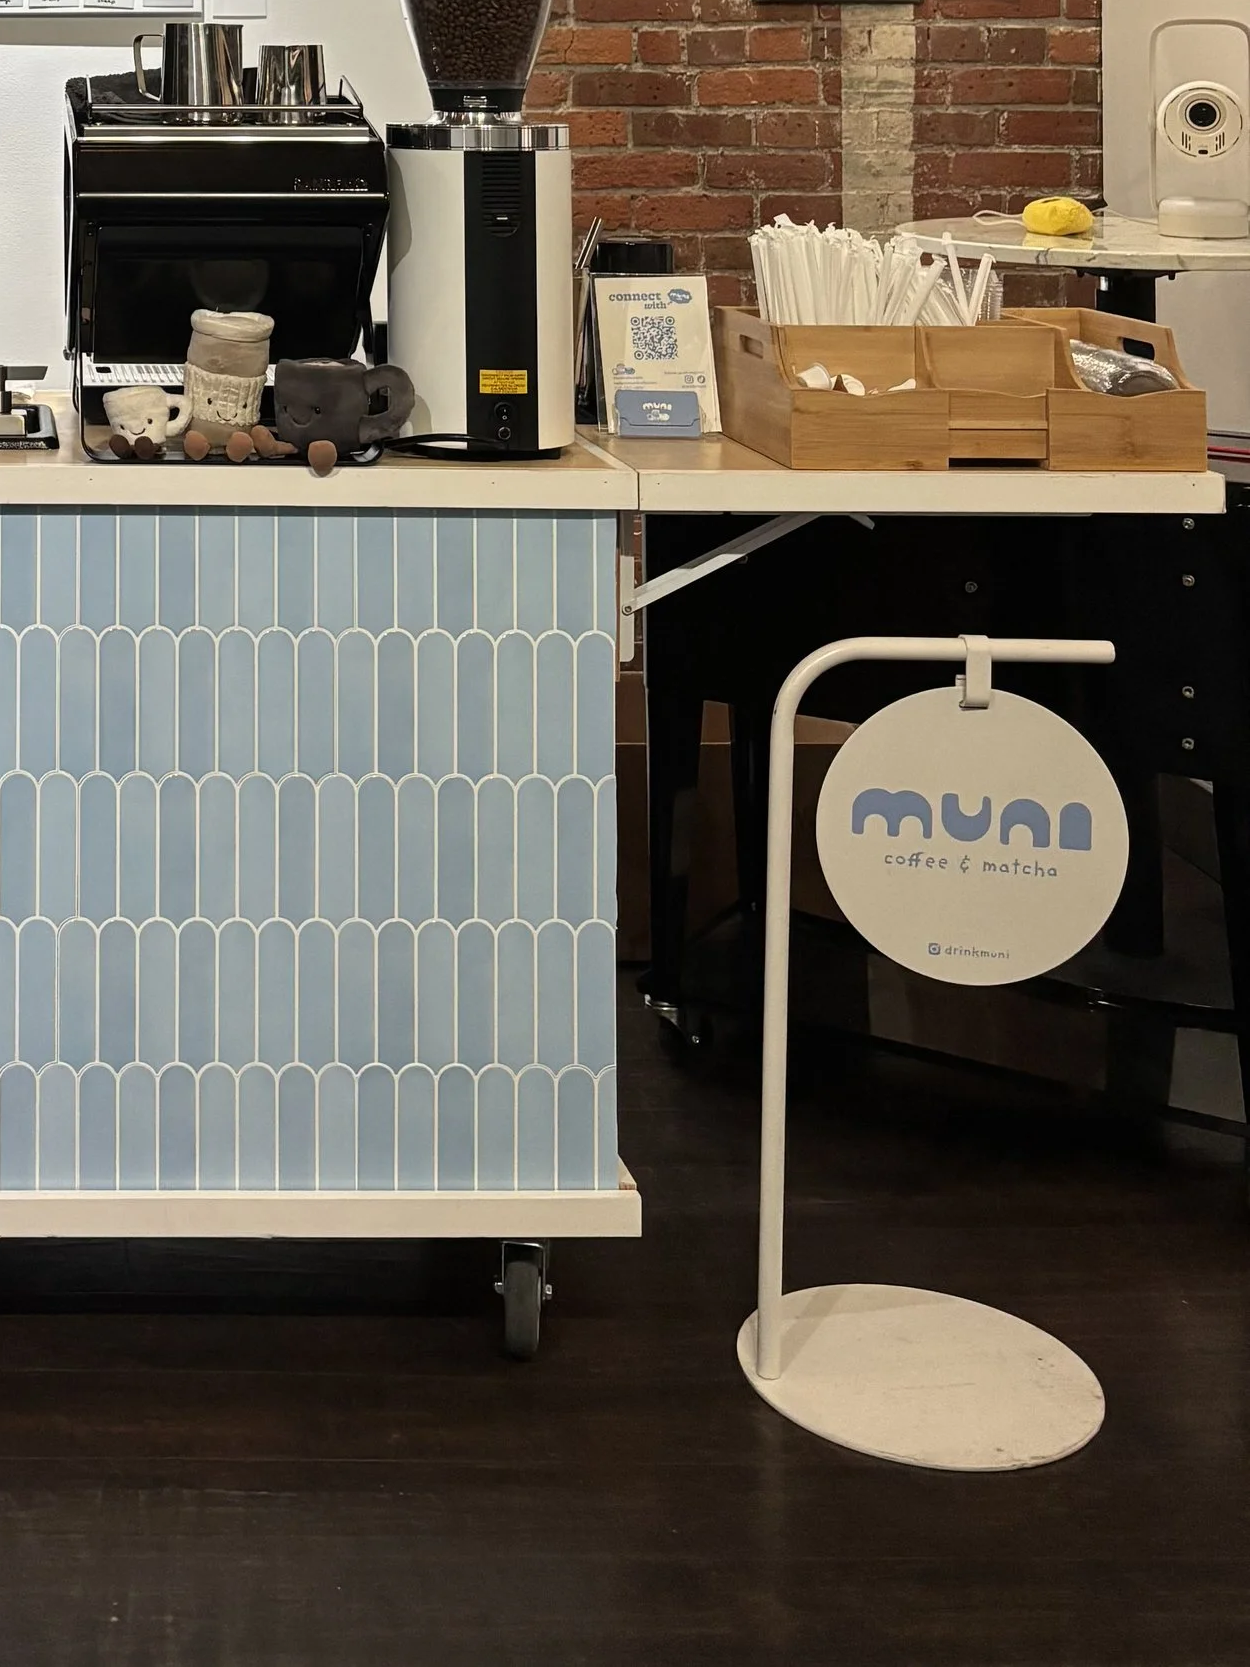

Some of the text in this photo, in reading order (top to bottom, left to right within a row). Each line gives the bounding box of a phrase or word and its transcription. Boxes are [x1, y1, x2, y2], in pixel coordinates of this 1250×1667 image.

[608, 292, 662, 302] connect
[644, 301, 667, 310] with
[642, 401, 672, 411] muni
[851, 787, 1092, 851] muni
[883, 851, 1058, 878] coffee & matcha
[944, 945, 1010, 960] drinkmuni
